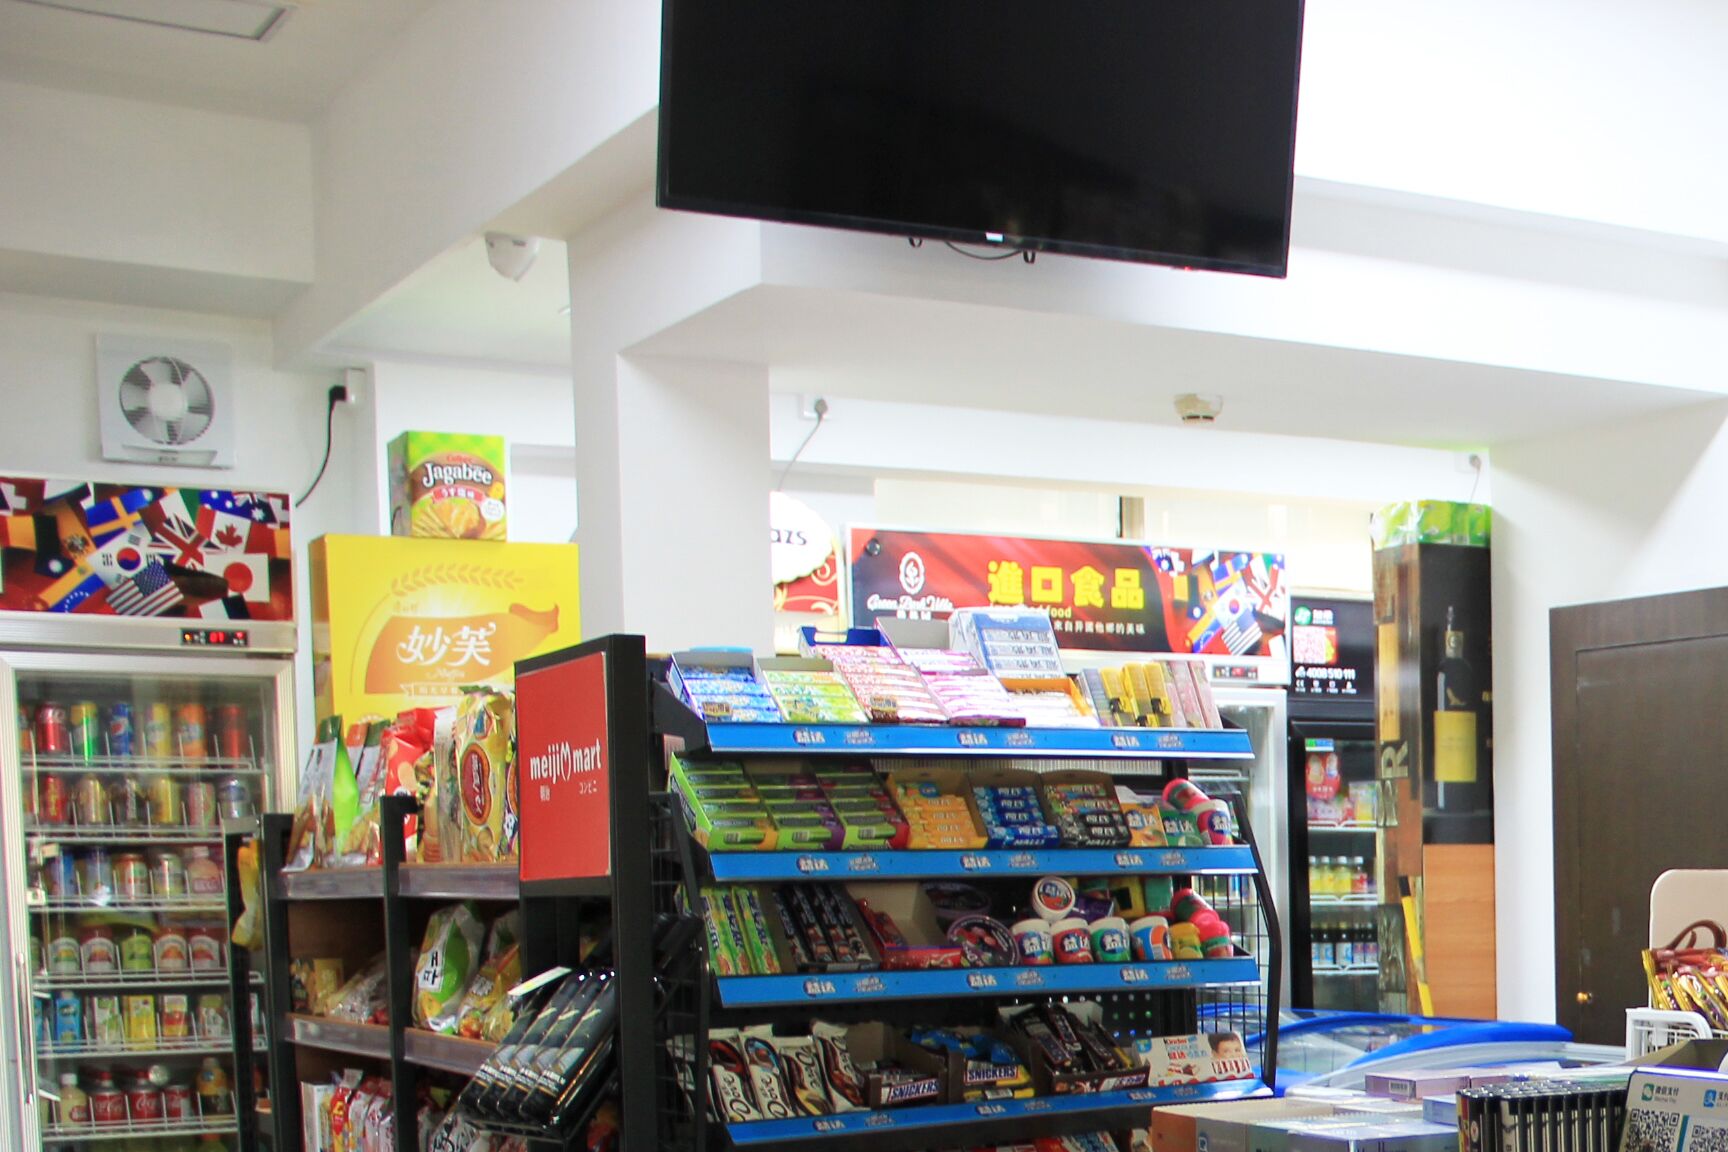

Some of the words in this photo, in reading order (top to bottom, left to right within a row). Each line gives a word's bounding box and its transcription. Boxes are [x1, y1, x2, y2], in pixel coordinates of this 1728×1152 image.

[422, 462, 493, 488] Jagabee
[1047, 604, 1073, 619] food
[396, 621, 497, 667] 妙芙
[529, 743, 561, 785] meiji
[573, 738, 602, 773] mart
[967, 1066, 1017, 1081] SNICKERS
[890, 1079, 939, 1100] SNICKERS
